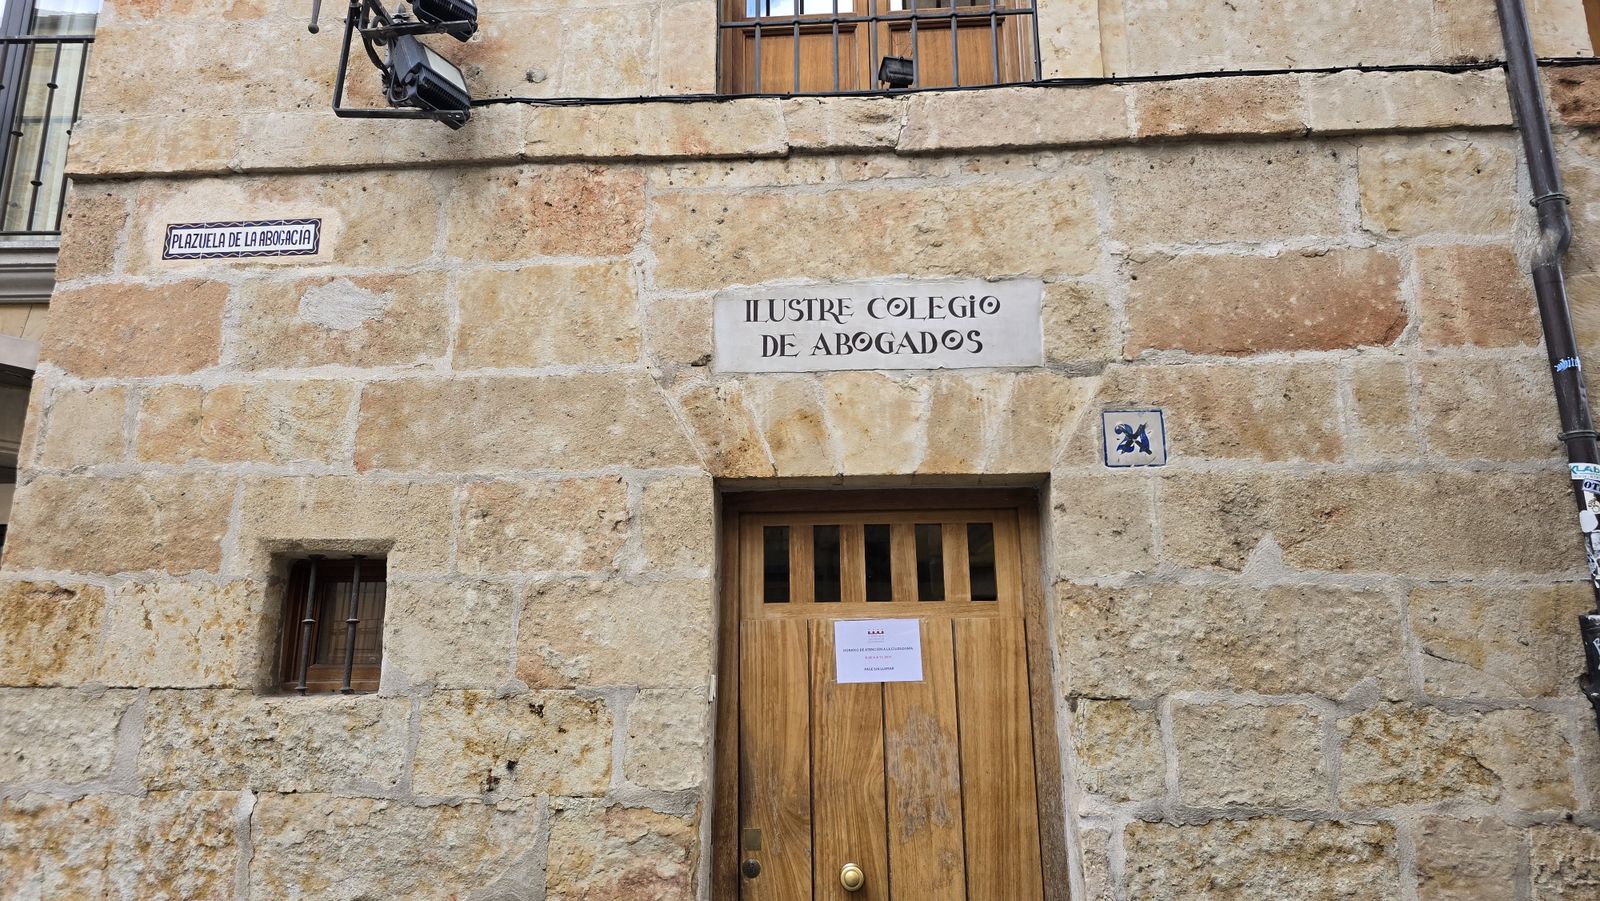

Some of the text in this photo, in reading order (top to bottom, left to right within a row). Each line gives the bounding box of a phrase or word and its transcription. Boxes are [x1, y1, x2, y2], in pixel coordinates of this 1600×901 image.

[171, 226, 311, 249] PLAZUELA DE LA ABOGACÍA
[744, 294, 1001, 325] ILUSTRE COLEGIO
[761, 329, 984, 358] DE ABOGADOS
